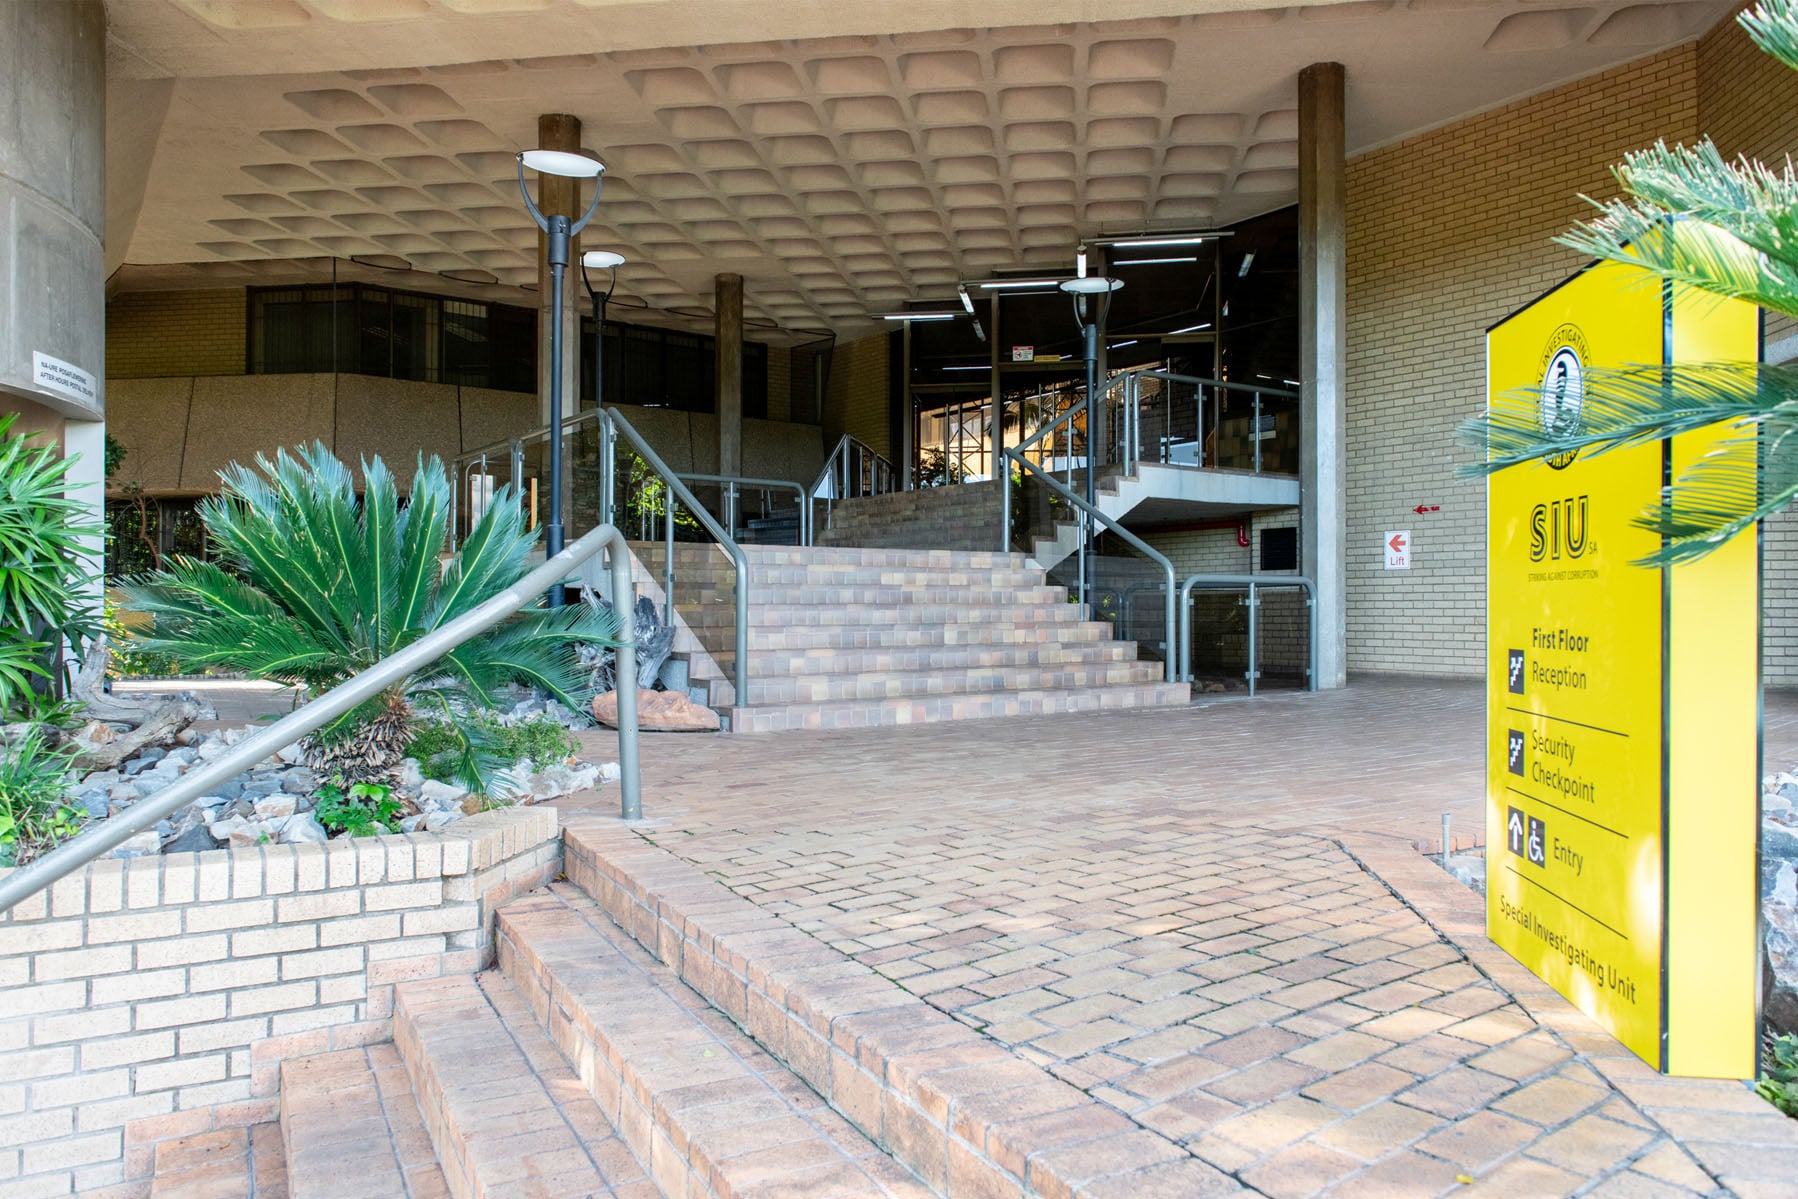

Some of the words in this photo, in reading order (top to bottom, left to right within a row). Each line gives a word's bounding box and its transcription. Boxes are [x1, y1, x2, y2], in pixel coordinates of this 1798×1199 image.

[1542, 328, 1589, 368] INVESTIGATING
[40, 371, 55, 381] AFTER
[56, 377, 69, 387] HOURS
[1529, 494, 1589, 563] SIU
[1390, 556, 1404, 566] Lift
[1567, 568, 1599, 580] CORRUPTION
[1532, 627, 1556, 650] First
[1558, 629, 1589, 653] Floor
[1532, 661, 1587, 691] Reception
[1532, 729, 1576, 766] Security
[1532, 761, 1595, 804] Checkpoint
[1554, 837, 1584, 877] Entry
[1500, 894, 1532, 931] Special
[1533, 915, 1604, 988] Investigating
[1608, 964, 1636, 1005] Unit
